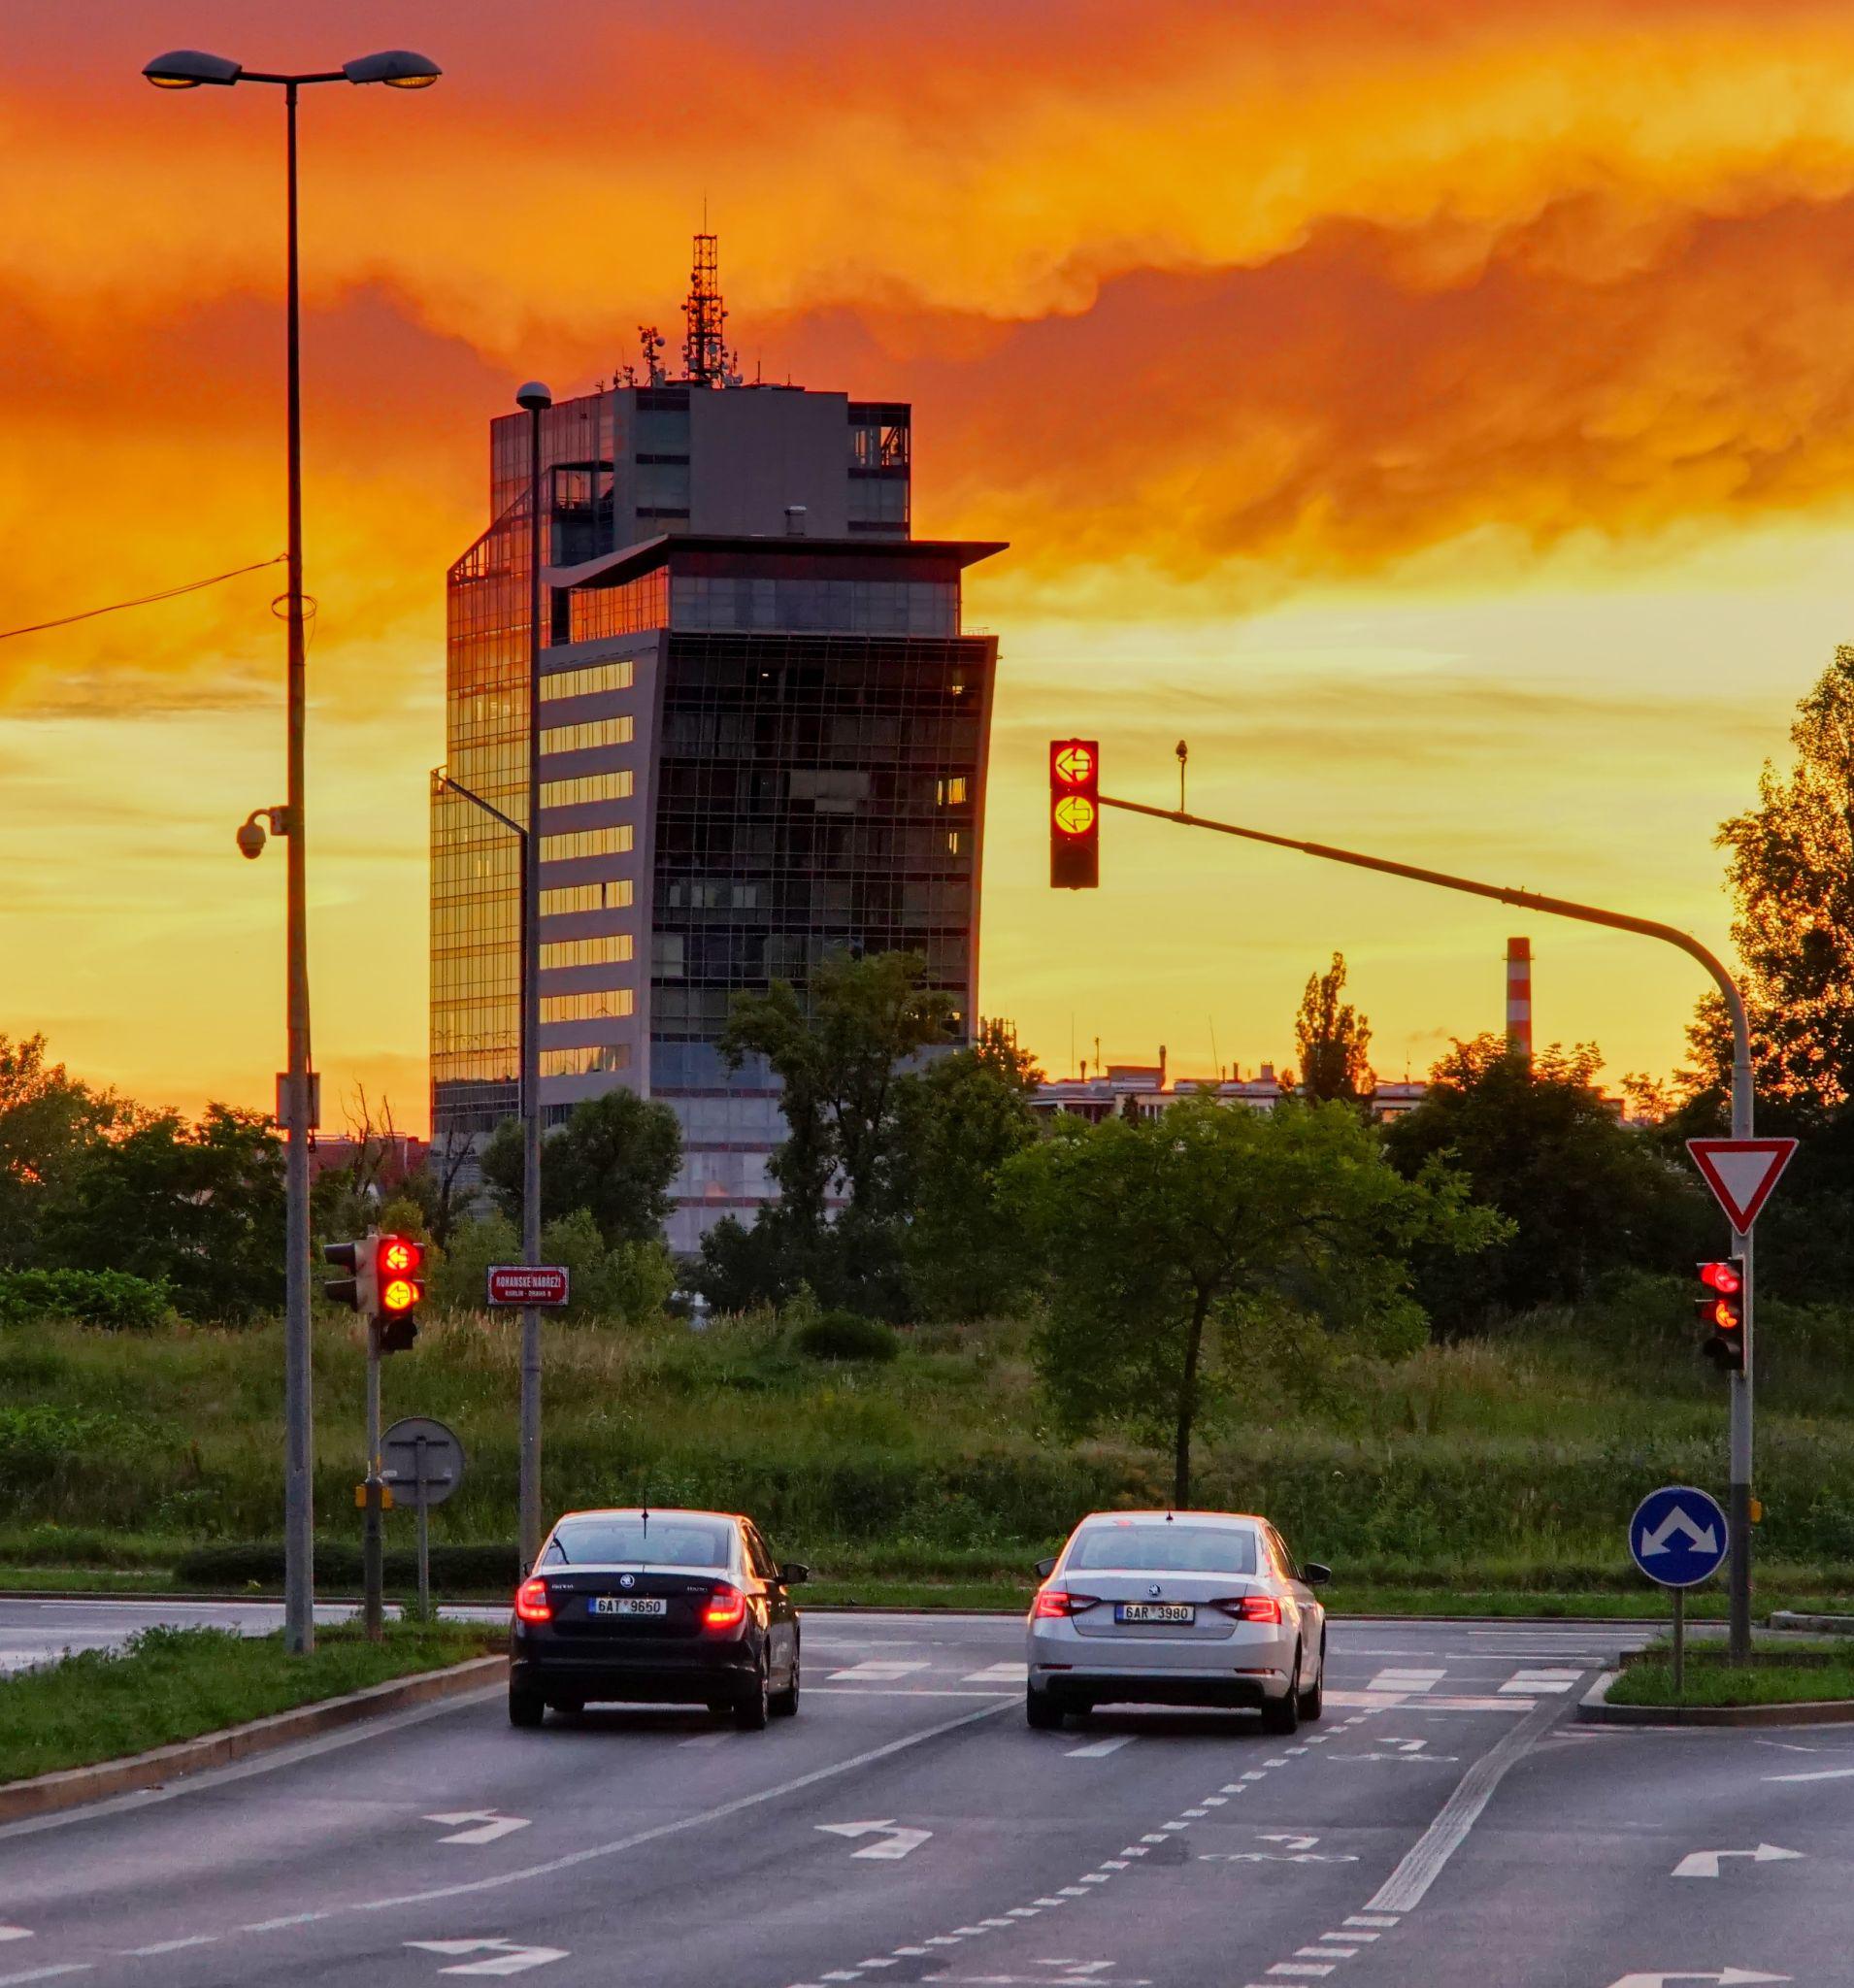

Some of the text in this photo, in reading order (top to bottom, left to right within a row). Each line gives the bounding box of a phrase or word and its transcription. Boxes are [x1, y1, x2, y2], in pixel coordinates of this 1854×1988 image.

[598, 1600, 620, 1612] 6AT
[1126, 1607, 1188, 1619] 6AR 3980
